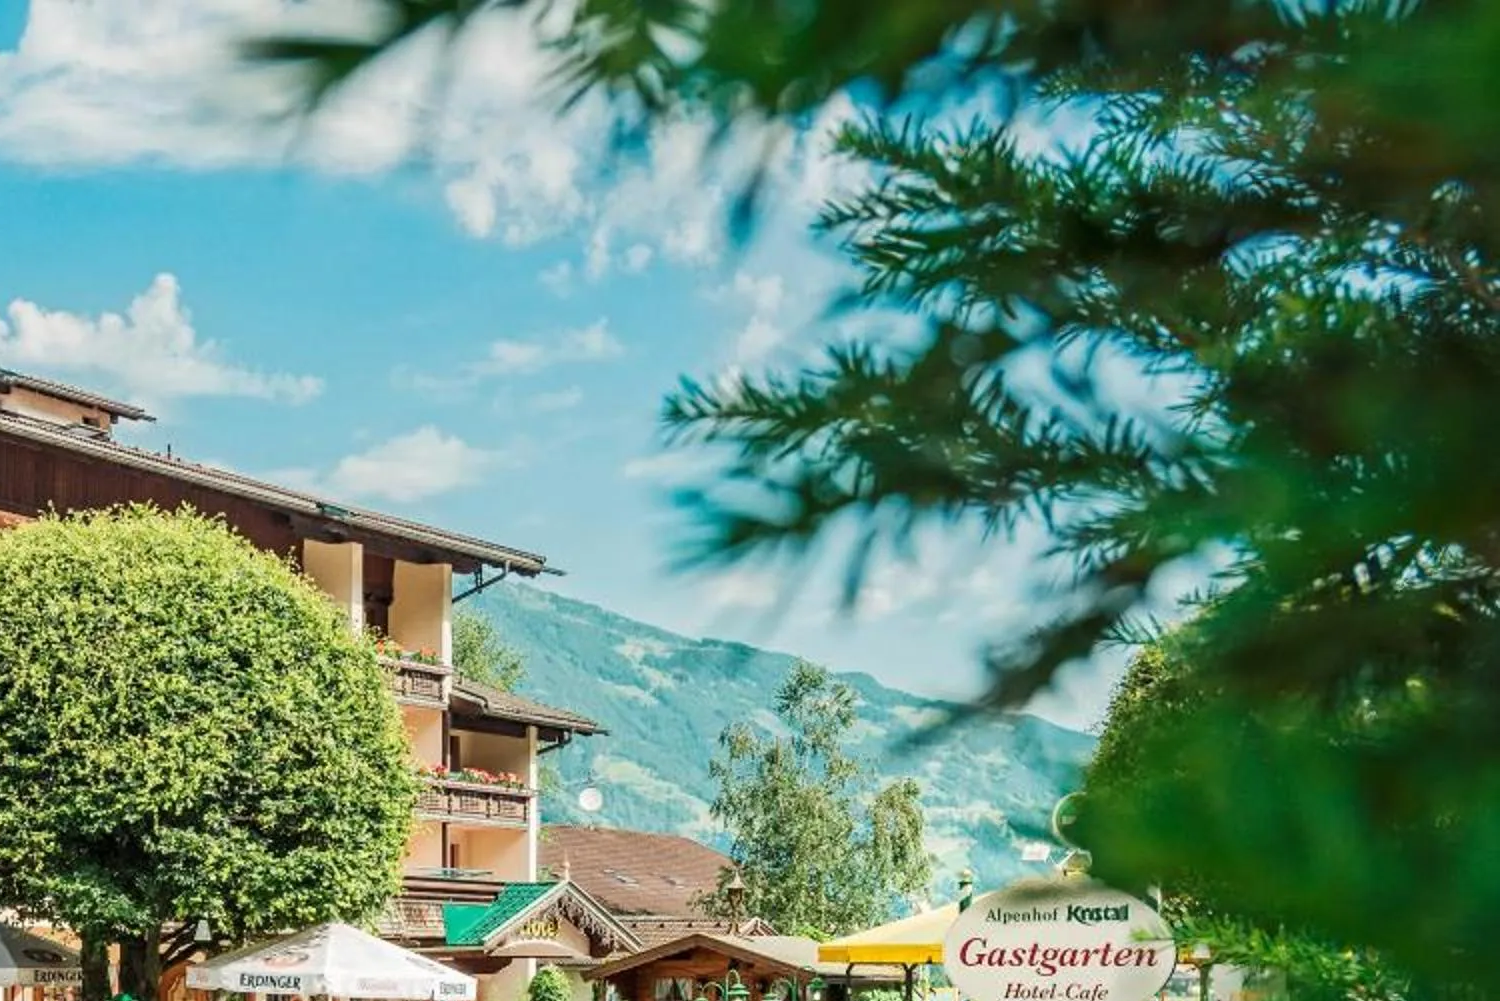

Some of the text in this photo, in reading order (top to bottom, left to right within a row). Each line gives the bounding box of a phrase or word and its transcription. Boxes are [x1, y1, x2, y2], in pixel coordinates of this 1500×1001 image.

[985, 903, 1129, 926] Alpenhof Kristall
[959, 936, 1158, 977] Gastgarten
[240, 973, 301, 991] ERDINGER
